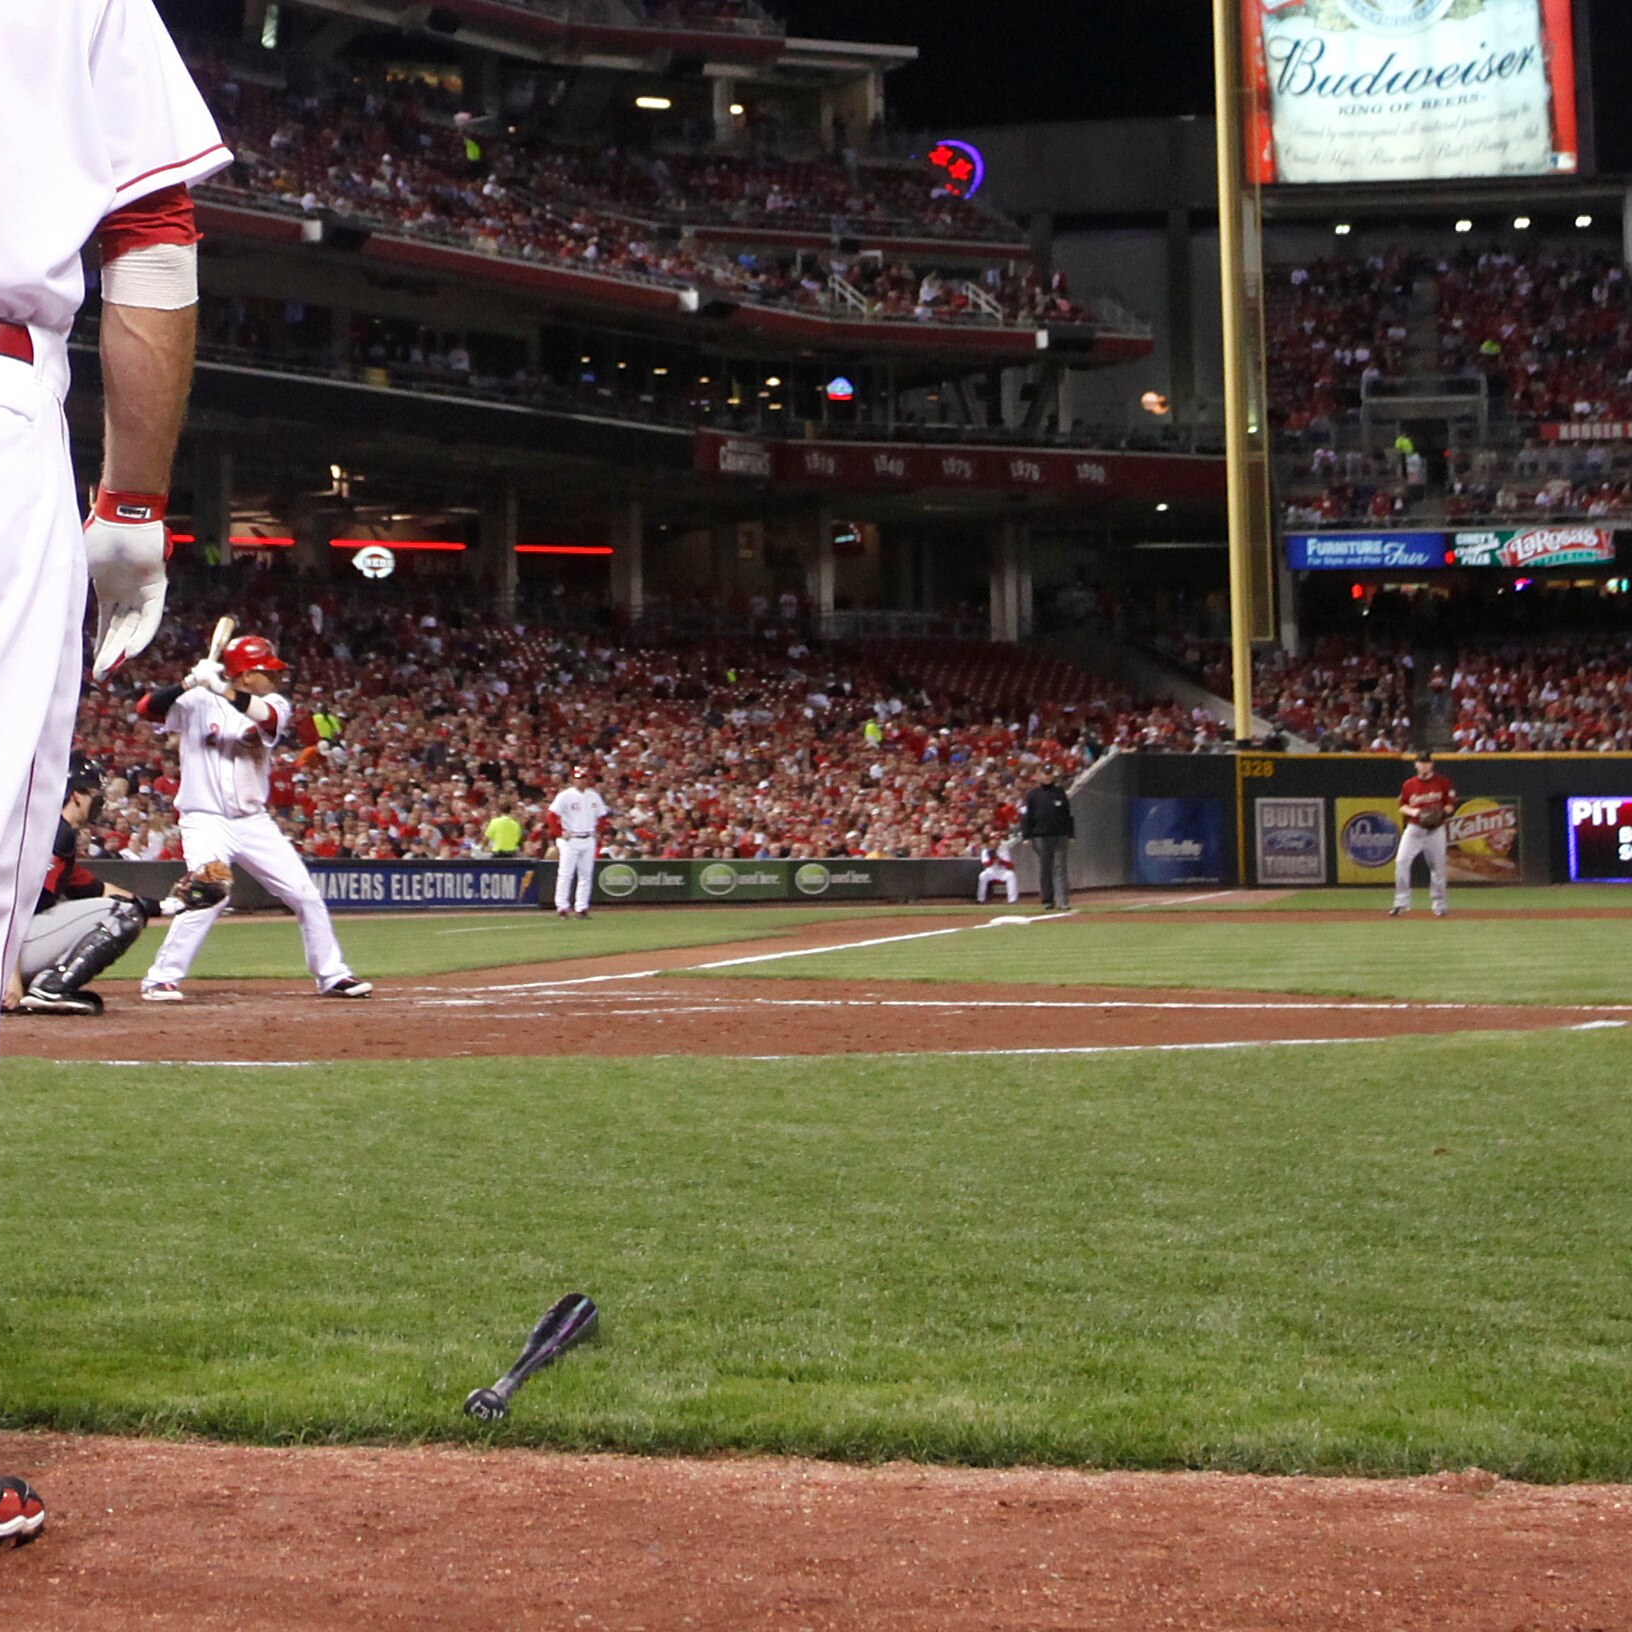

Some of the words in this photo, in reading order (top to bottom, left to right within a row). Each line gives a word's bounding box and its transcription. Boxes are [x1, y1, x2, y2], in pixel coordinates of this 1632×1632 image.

[1269, 36, 1535, 99] Budweiser
[1338, 103, 1384, 116] KING
[1389, 101, 1414, 113] OF
[1383, 542, 1429, 565] Fair
[1241, 760, 1274, 777] 328
[1262, 806, 1316, 828] BUILT
[1449, 809, 1516, 840] Kahn's
[1572, 801, 1622, 825] PIT
[1274, 832, 1309, 849] Ford
[391, 872, 516, 900] ELECTRIC.COM
